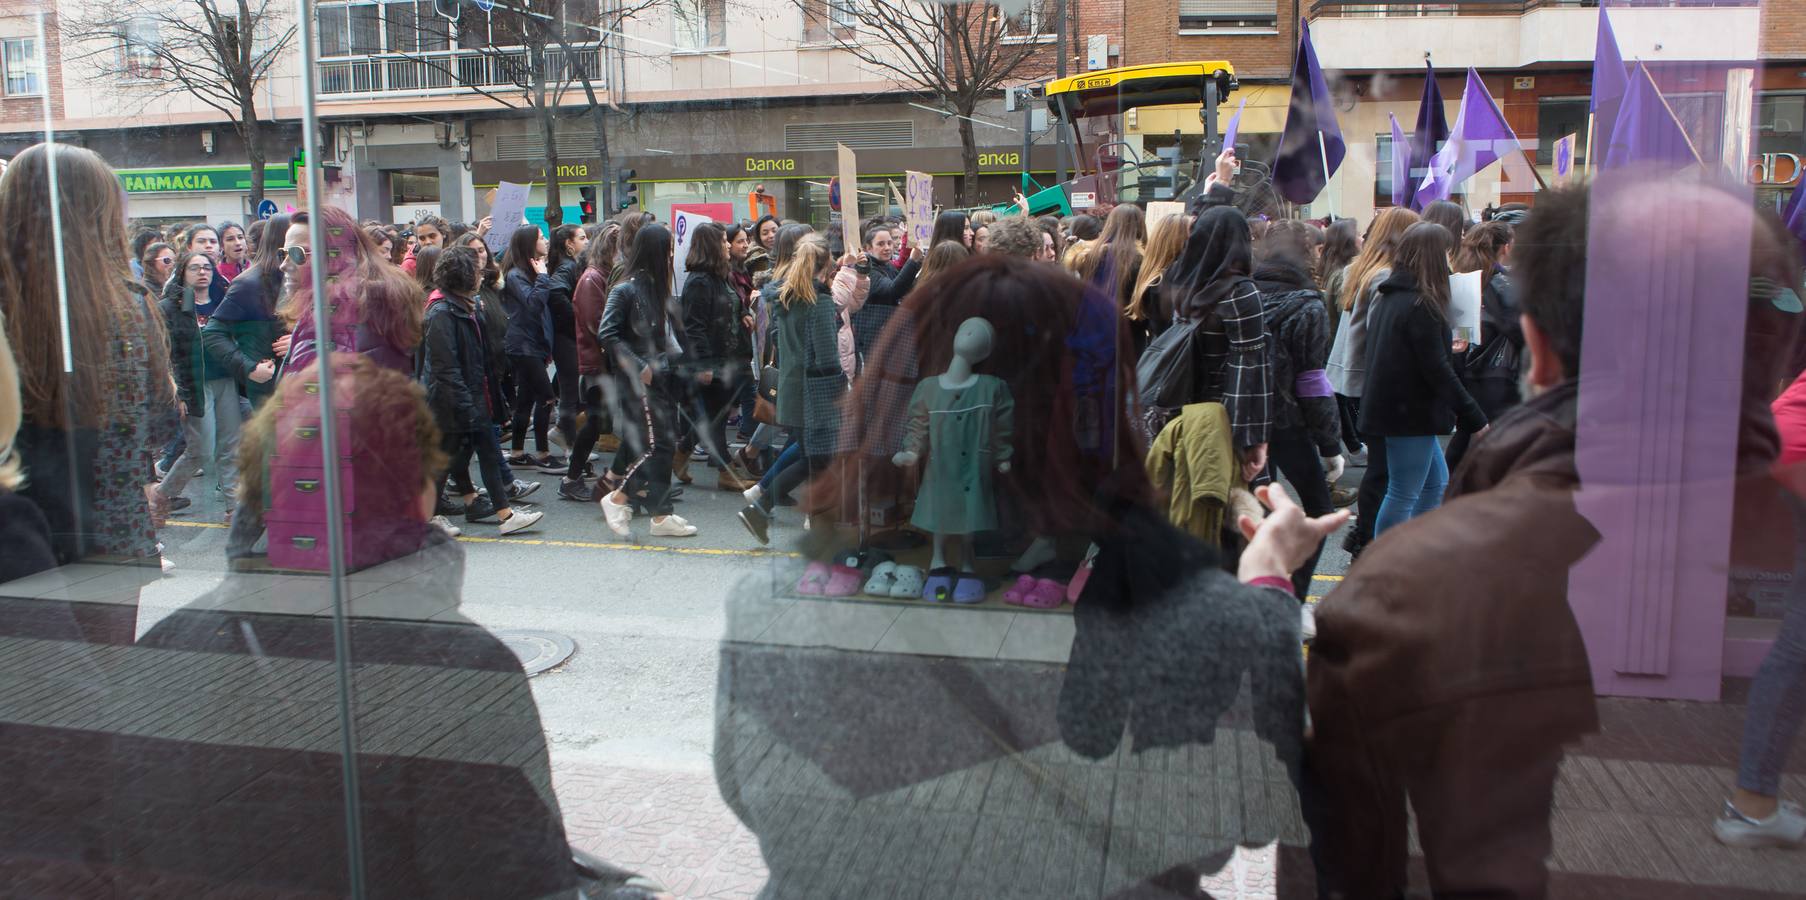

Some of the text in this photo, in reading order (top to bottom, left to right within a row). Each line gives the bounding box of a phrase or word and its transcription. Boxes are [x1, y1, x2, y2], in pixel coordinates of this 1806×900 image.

[746, 158, 795, 171] Bankia
[978, 152, 1020, 166] ankia
[543, 164, 588, 177] nkia
[125, 174, 213, 191] FARMACIA
